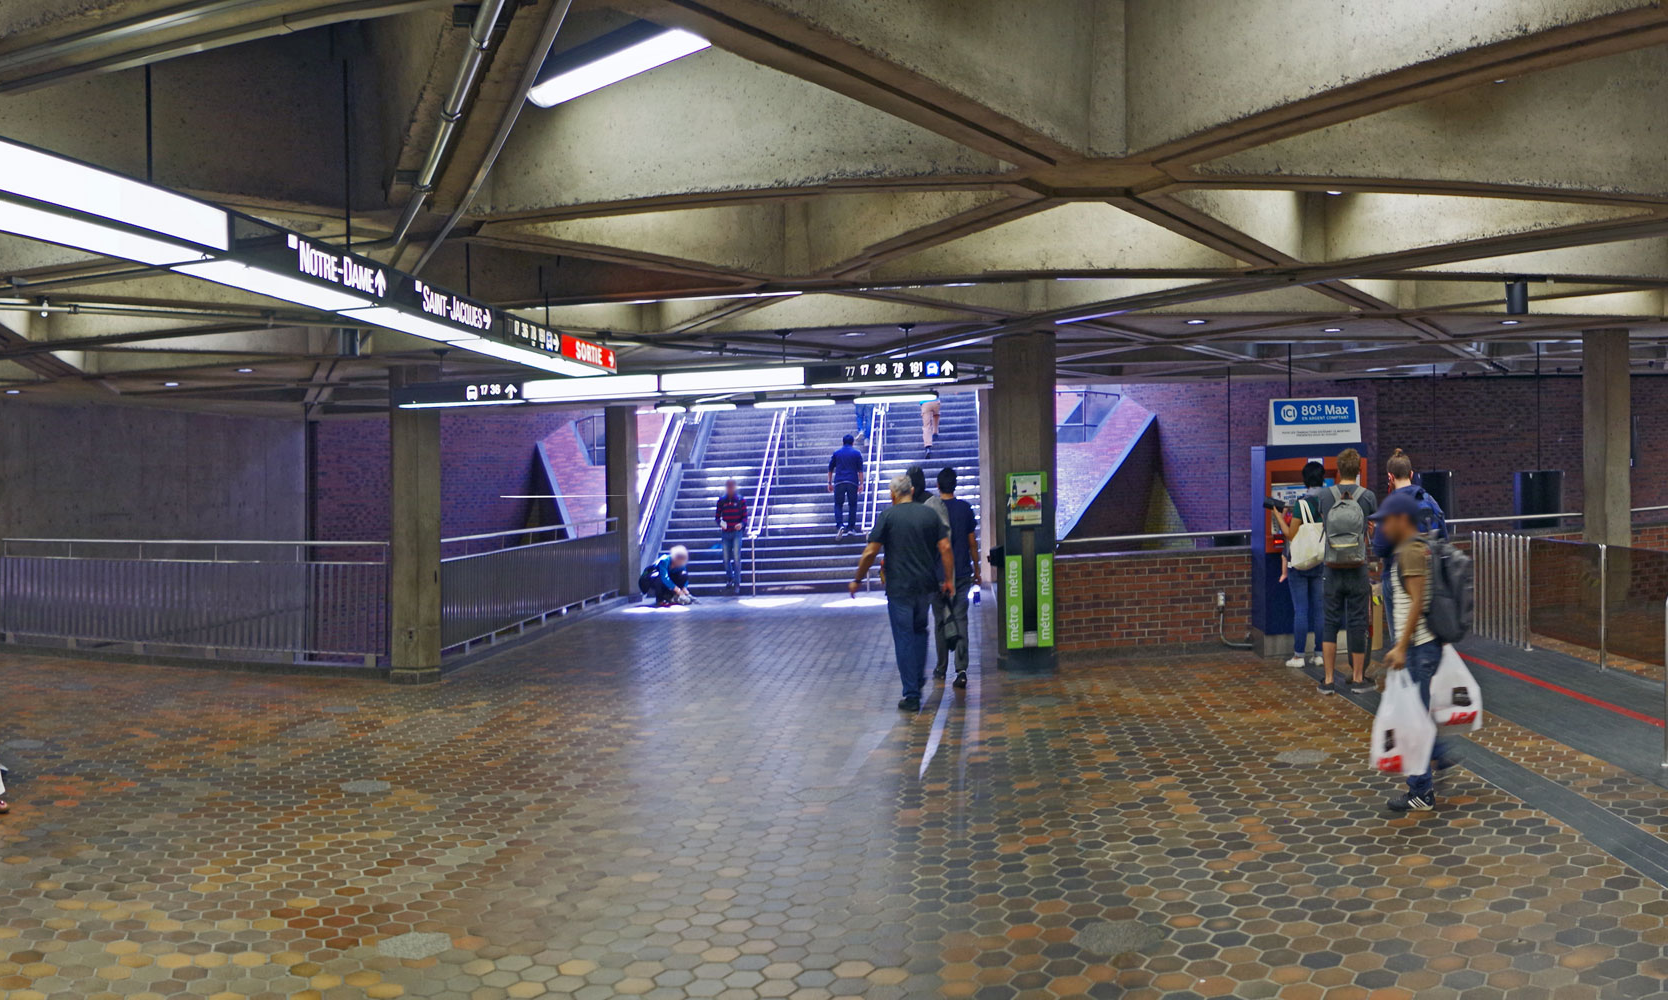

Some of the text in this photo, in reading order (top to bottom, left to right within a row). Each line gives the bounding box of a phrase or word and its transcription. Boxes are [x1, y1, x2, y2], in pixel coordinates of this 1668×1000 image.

[421, 285, 483, 330] SAINT-JACQUES
[575, 340, 603, 366] SORTIE
[859, 364, 870, 376] 17
[909, 361, 923, 373] 191
[480, 384, 489, 396] 17
[1282, 408, 1296, 418] ICI
[1324, 404, 1349, 415] Max
